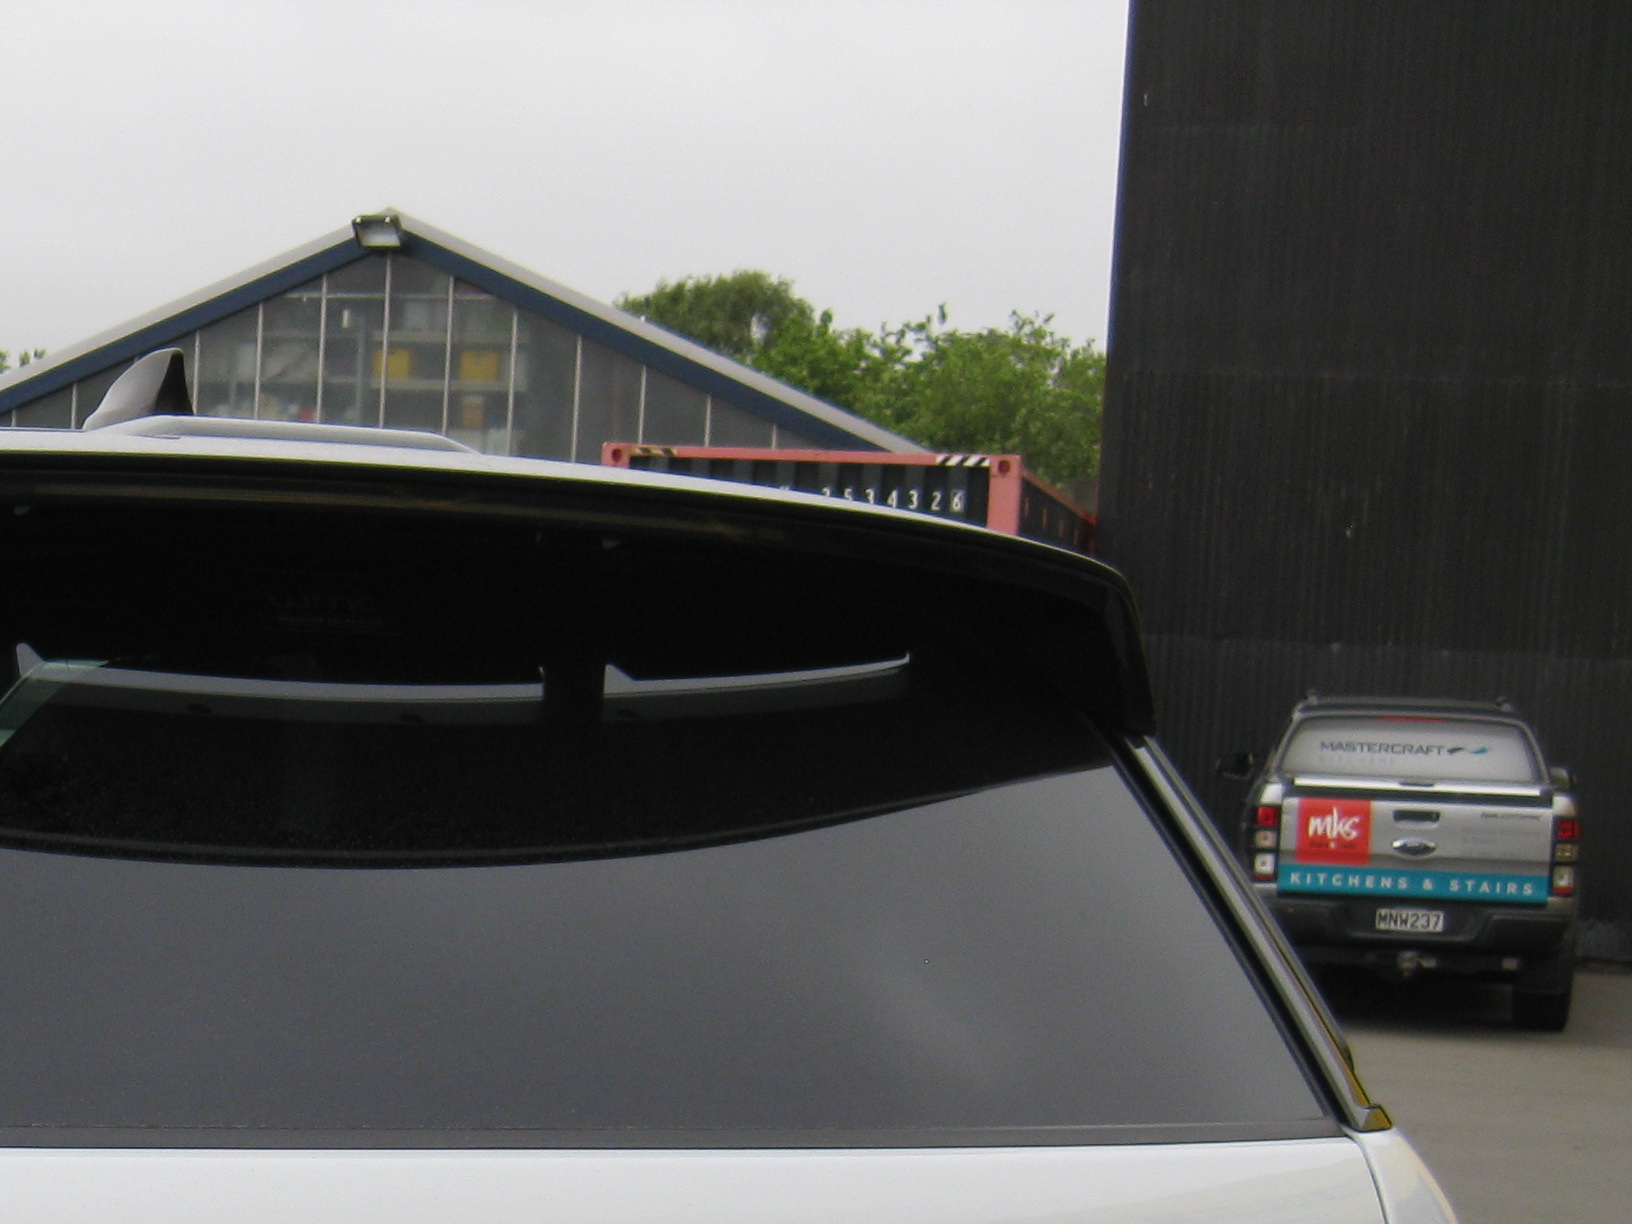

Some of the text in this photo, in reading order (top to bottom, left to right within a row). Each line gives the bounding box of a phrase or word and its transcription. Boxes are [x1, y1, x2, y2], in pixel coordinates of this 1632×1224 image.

[1320, 741, 1446, 756] MASTERCRAFT
[1308, 806, 1361, 841] mks
[1290, 872, 1534, 896] KITCHENS & STAIRS
[1377, 911, 1443, 930] MNW237
